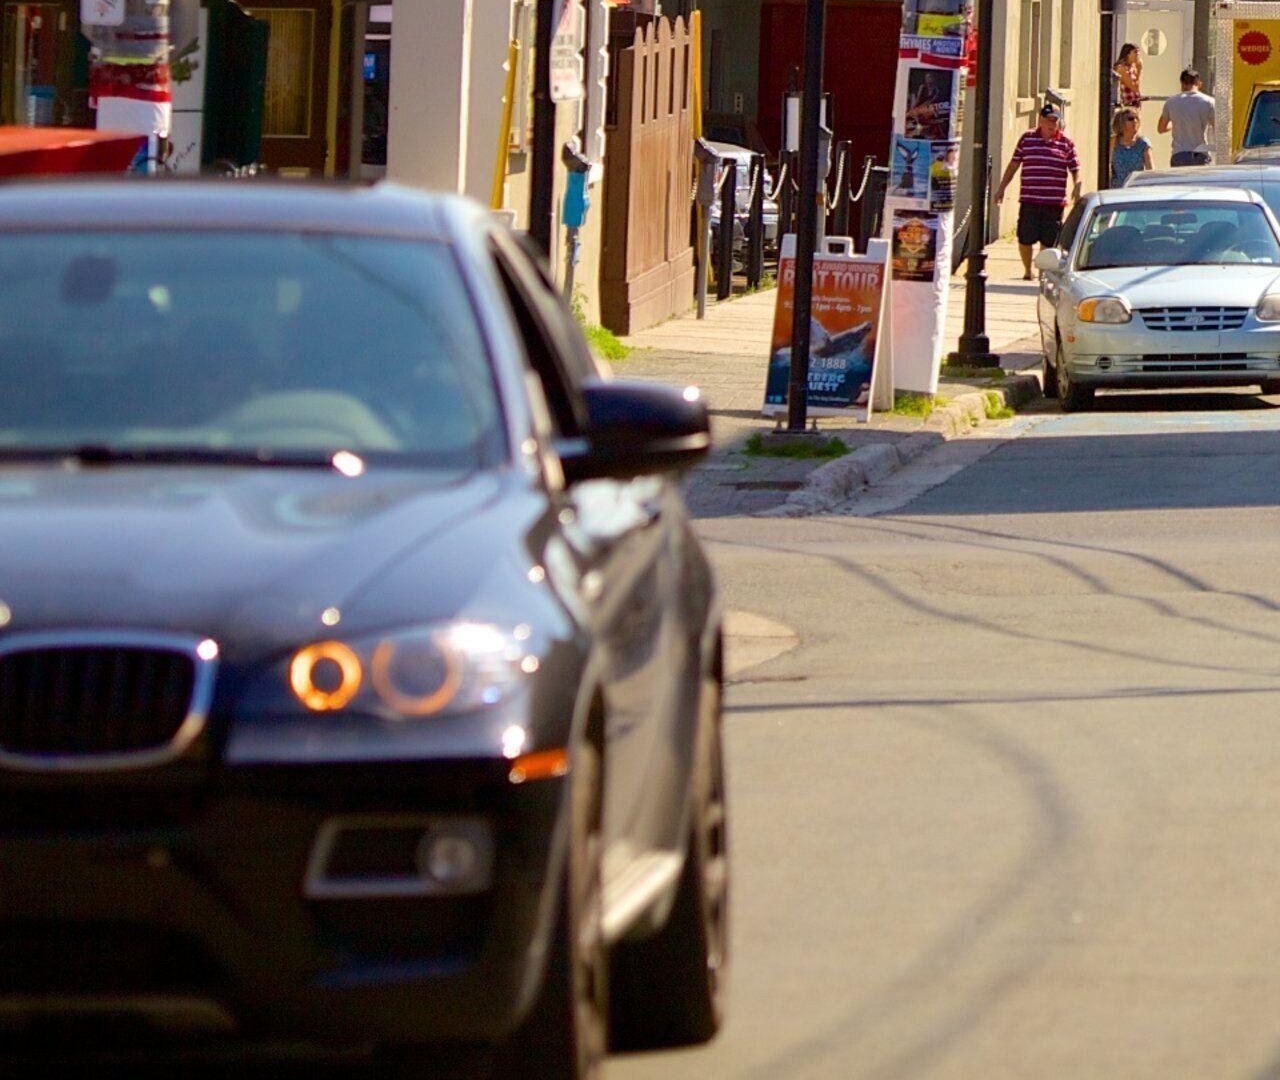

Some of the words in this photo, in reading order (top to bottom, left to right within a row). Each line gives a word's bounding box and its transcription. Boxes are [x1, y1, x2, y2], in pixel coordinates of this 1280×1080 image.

[1240, 45, 1270, 53] WEDGES
[832, 271, 879, 292] TOUR
[809, 382, 839, 392] UEST
